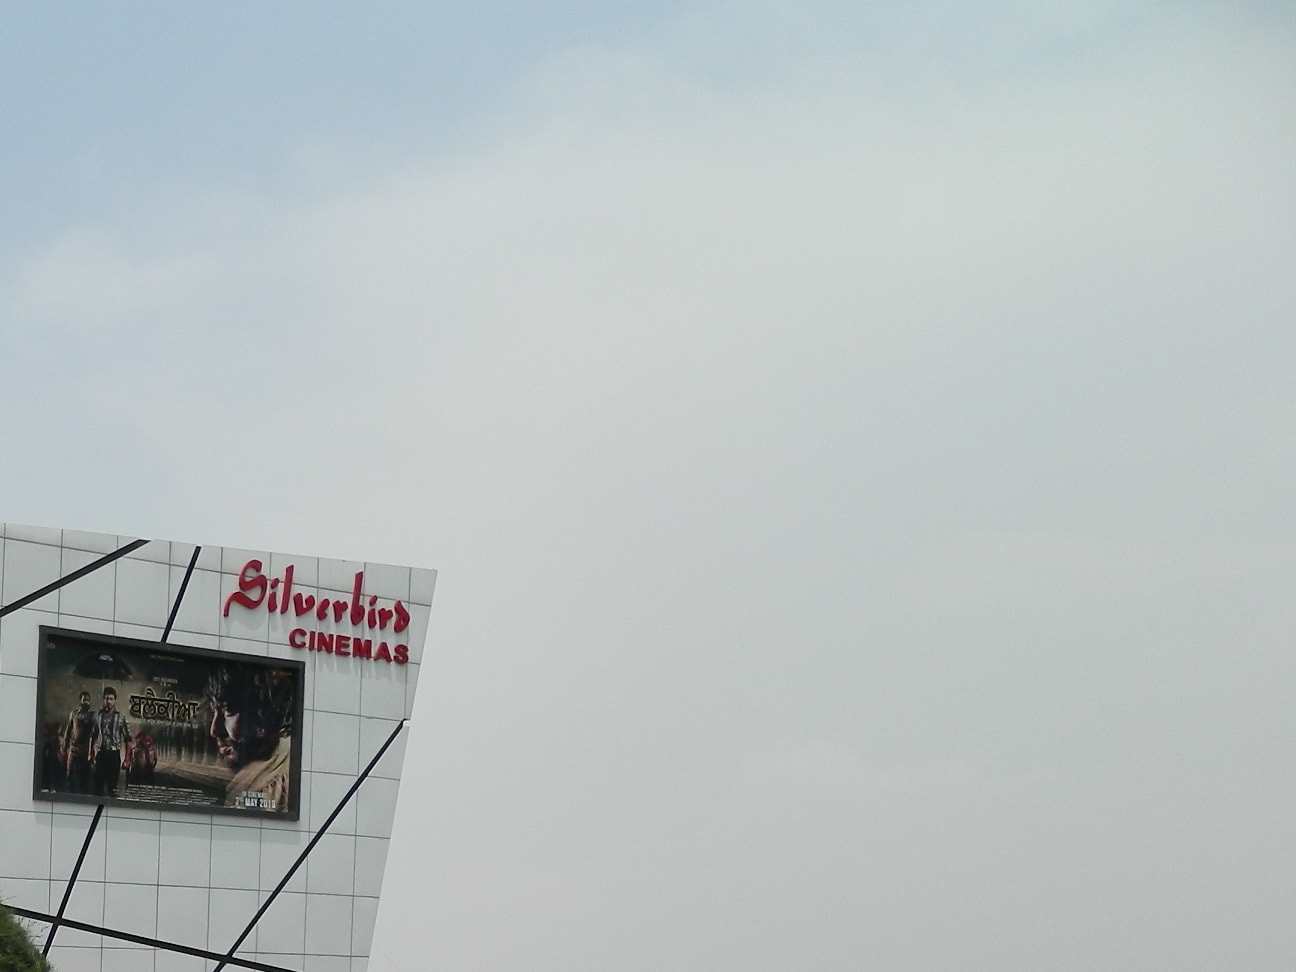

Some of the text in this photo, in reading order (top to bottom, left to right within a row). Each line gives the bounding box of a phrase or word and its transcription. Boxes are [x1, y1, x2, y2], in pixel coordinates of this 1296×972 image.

[223, 559, 411, 634] Silverbird
[288, 628, 409, 664] CINEMAS
[245, 797, 258, 807] MAY
[259, 799, 276, 808] 2019
